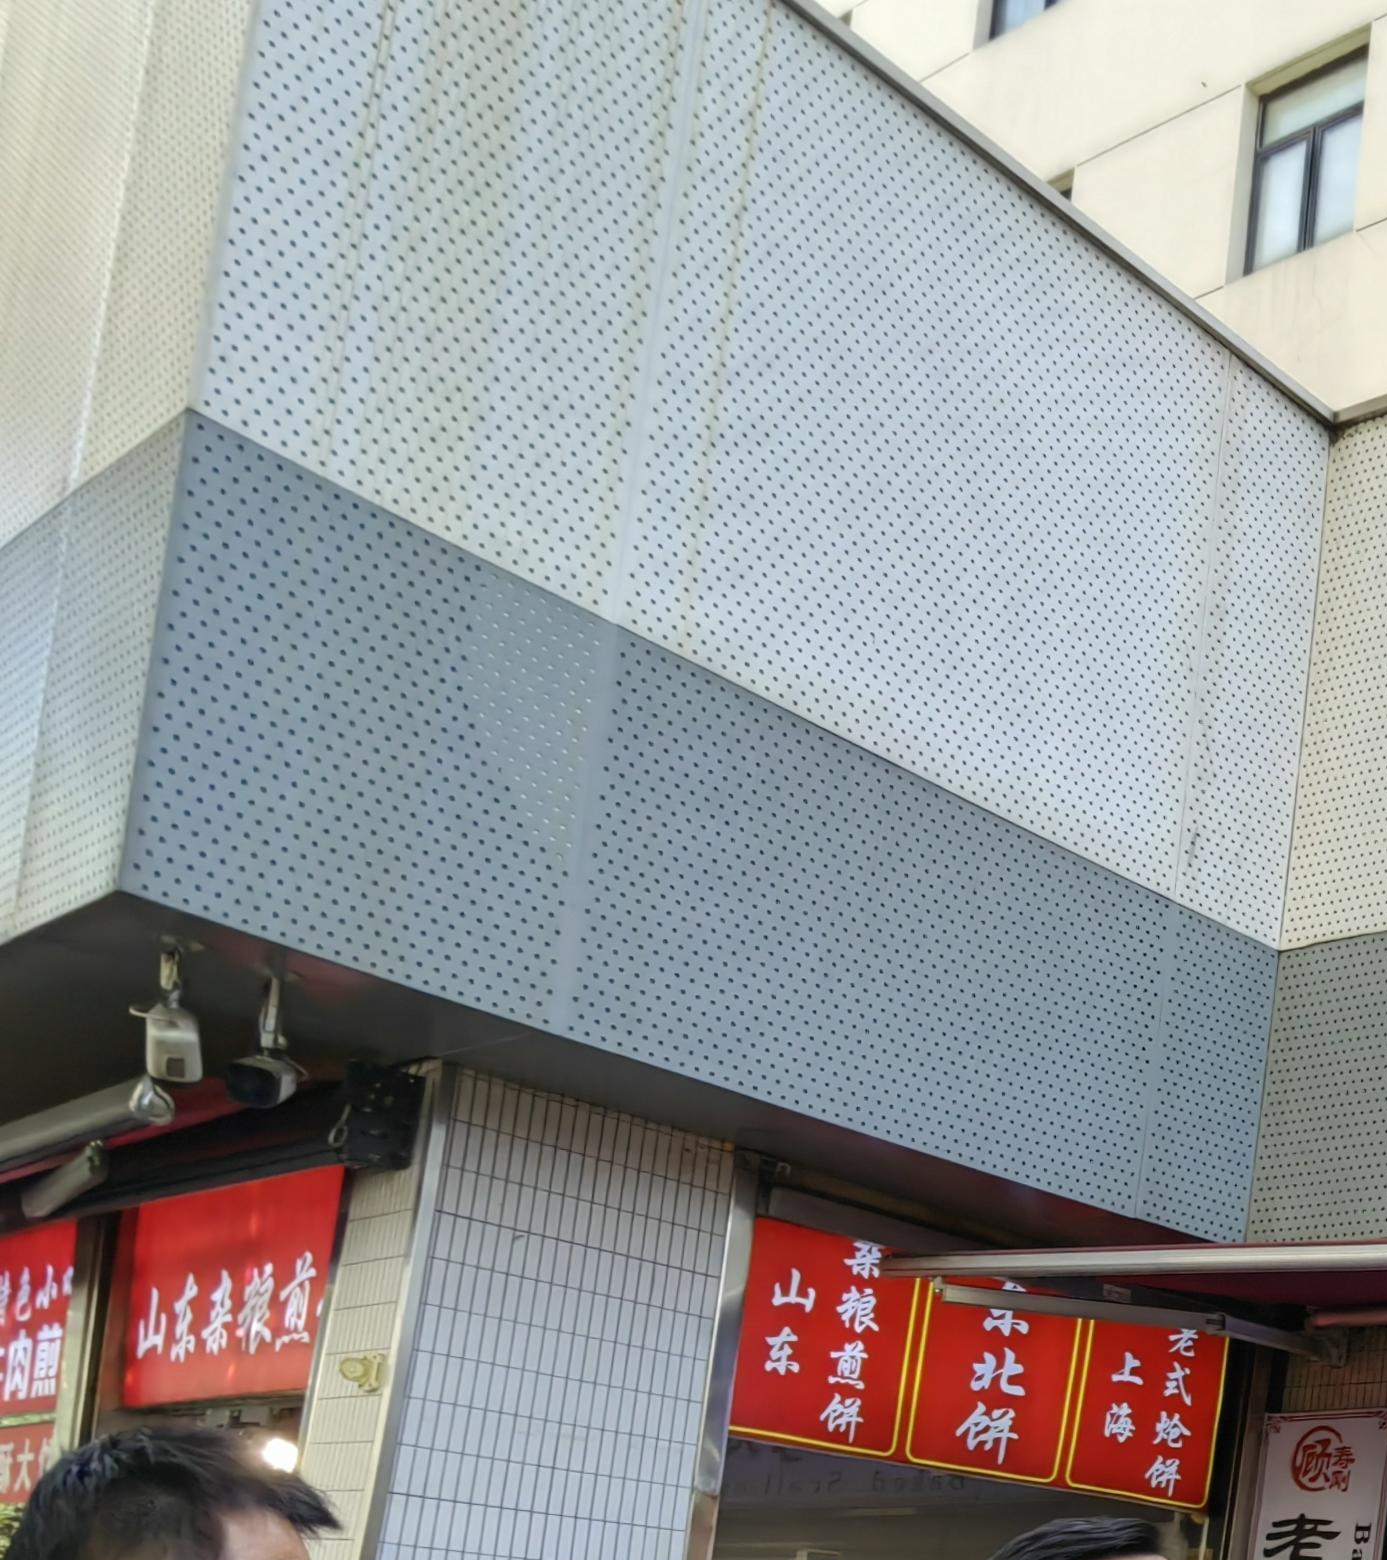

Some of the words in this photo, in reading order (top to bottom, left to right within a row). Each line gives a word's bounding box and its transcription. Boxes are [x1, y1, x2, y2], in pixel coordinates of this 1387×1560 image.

[136, 1251, 324, 1363] 山东杂粮煎
[764, 1267, 816, 1376] 山东
[819, 1240, 883, 1444] 杂粮煎饼
[0, 1322, 64, 1402] 肉煎
[1103, 1351, 1144, 1443] 上海
